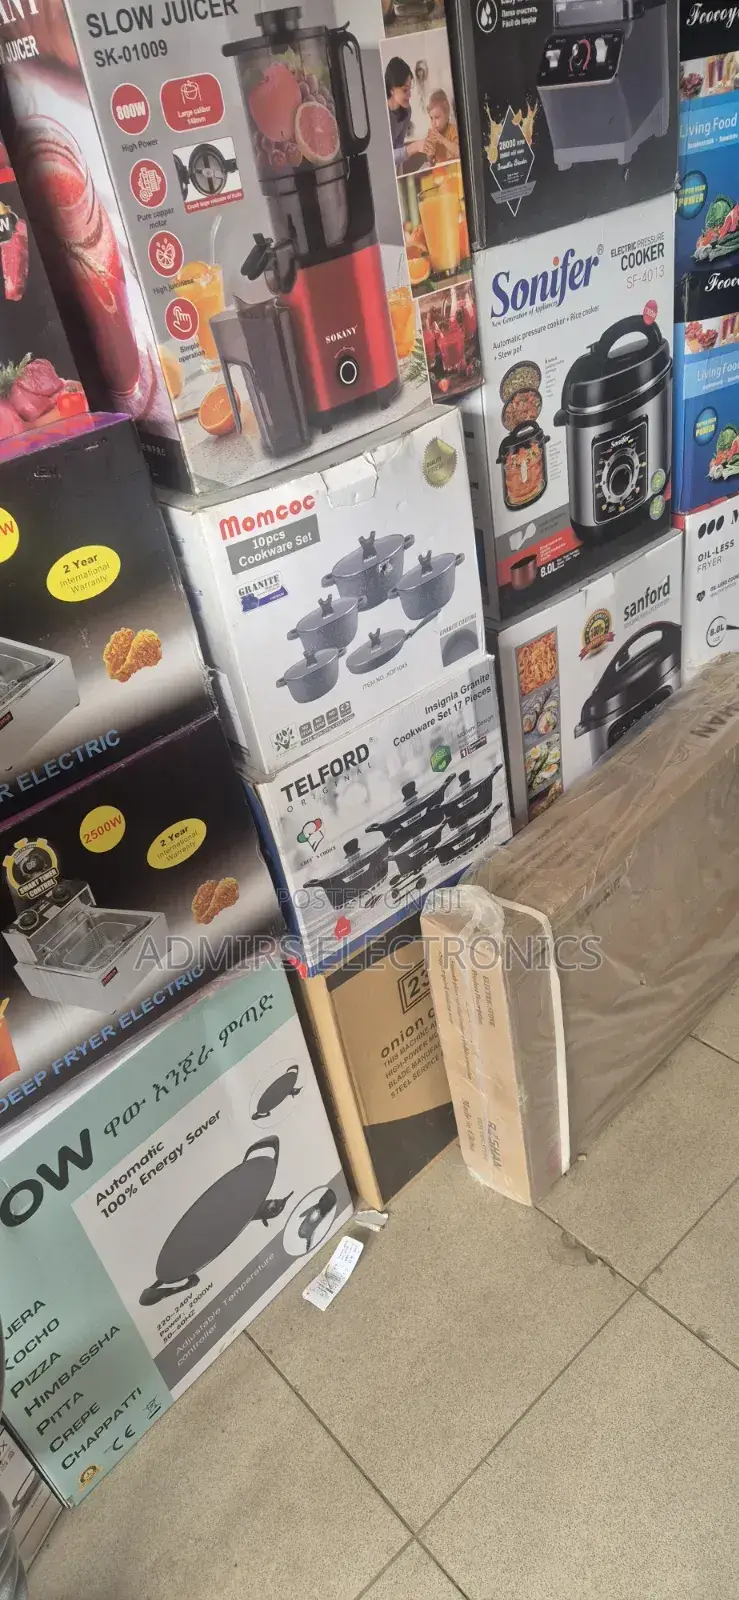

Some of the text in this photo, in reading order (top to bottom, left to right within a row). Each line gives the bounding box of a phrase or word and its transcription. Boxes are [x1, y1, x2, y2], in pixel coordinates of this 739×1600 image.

[86, 0, 238, 39] SLOW JUICER
[5, 35, 39, 62] JUICER
[94, 39, 168, 68] SK-01009
[116, 101, 146, 121] 800W
[177, 109, 193, 119] Large
[680, 113, 737, 139] Living Food
[121, 138, 158, 154] High Power
[137, 207, 174, 222] Pure copper
[149, 218, 168, 230] motor
[611, 232, 665, 258] ELECTRIC PRESSURE
[621, 242, 665, 271] COOKER
[153, 284, 166, 296] High
[490, 248, 600, 319] Sonifer
[626, 265, 665, 290] SF-4013
[493, 331, 522, 351] Automatic
[522, 325, 547, 342] pressure
[547, 317, 565, 330] cooker
[570, 311, 582, 321] Rice
[582, 304, 600, 318] cooker
[501, 311, 528, 326] Generation
[325, 324, 358, 344] SOKANY
[178, 349, 206, 364] operation
[179, 342, 199, 354] Simple
[497, 348, 511, 361] Stew
[512, 345, 522, 356] pot
[697, 365, 721, 382] Living
[219, 494, 316, 541] Momcoc
[239, 531, 313, 567] Cookware Set
[252, 531, 286, 550] 10pcs
[697, 539, 735, 562] OIL-LESS
[60, 561, 111, 588] International
[63, 553, 99, 575] 2 Year
[540, 560, 558, 578] 8.0L
[696, 555, 722, 573] FRYER
[70, 575, 108, 596] Warranty
[238, 574, 280, 597] GRANITE
[623, 575, 671, 622] sanford
[424, 672, 491, 715] Insignia Granite
[392, 684, 492, 748] Cookware Set 17 Pieces
[16, 729, 120, 793] ELECTRIC
[280, 743, 370, 803] TELFORD
[83, 814, 122, 845] 2500W
[160, 826, 189, 847] 2 Year
[157, 830, 198, 860] International
[166, 840, 196, 862] Warranty
[19, 868, 57, 895] SMART TIMER
[29, 880, 56, 898] CONTROL
[0, 964, 204, 1114] DEEP FRYER ELECTRIC
[381, 1016, 424, 1059] onion
[384, 1027, 429, 1067] THIS MACHINE
[385, 1037, 428, 1080] HIGH-POWER
[388, 1066, 412, 1089] BLADE
[391, 1055, 439, 1099] STEEL SERVICE
[463, 1100, 471, 1120] Made
[96, 1141, 165, 1207] Automatic
[100, 1108, 221, 1219] 100% Energy Saver
[176, 1252, 275, 1356] Adjustable Temperature
[188, 1282, 214, 1309] 2000W
[156, 1292, 194, 1331] 220-240V
[163, 1309, 197, 1344] 50-60HZ
[176, 1322, 218, 1367] controller
[10, 1352, 62, 1399] PIZZA
[24, 1325, 121, 1418] HIMBASSHA
[35, 1391, 84, 1437] PITTA
[49, 1402, 100, 1453] CREPE
[61, 1386, 142, 1471] CHAPPATTI
